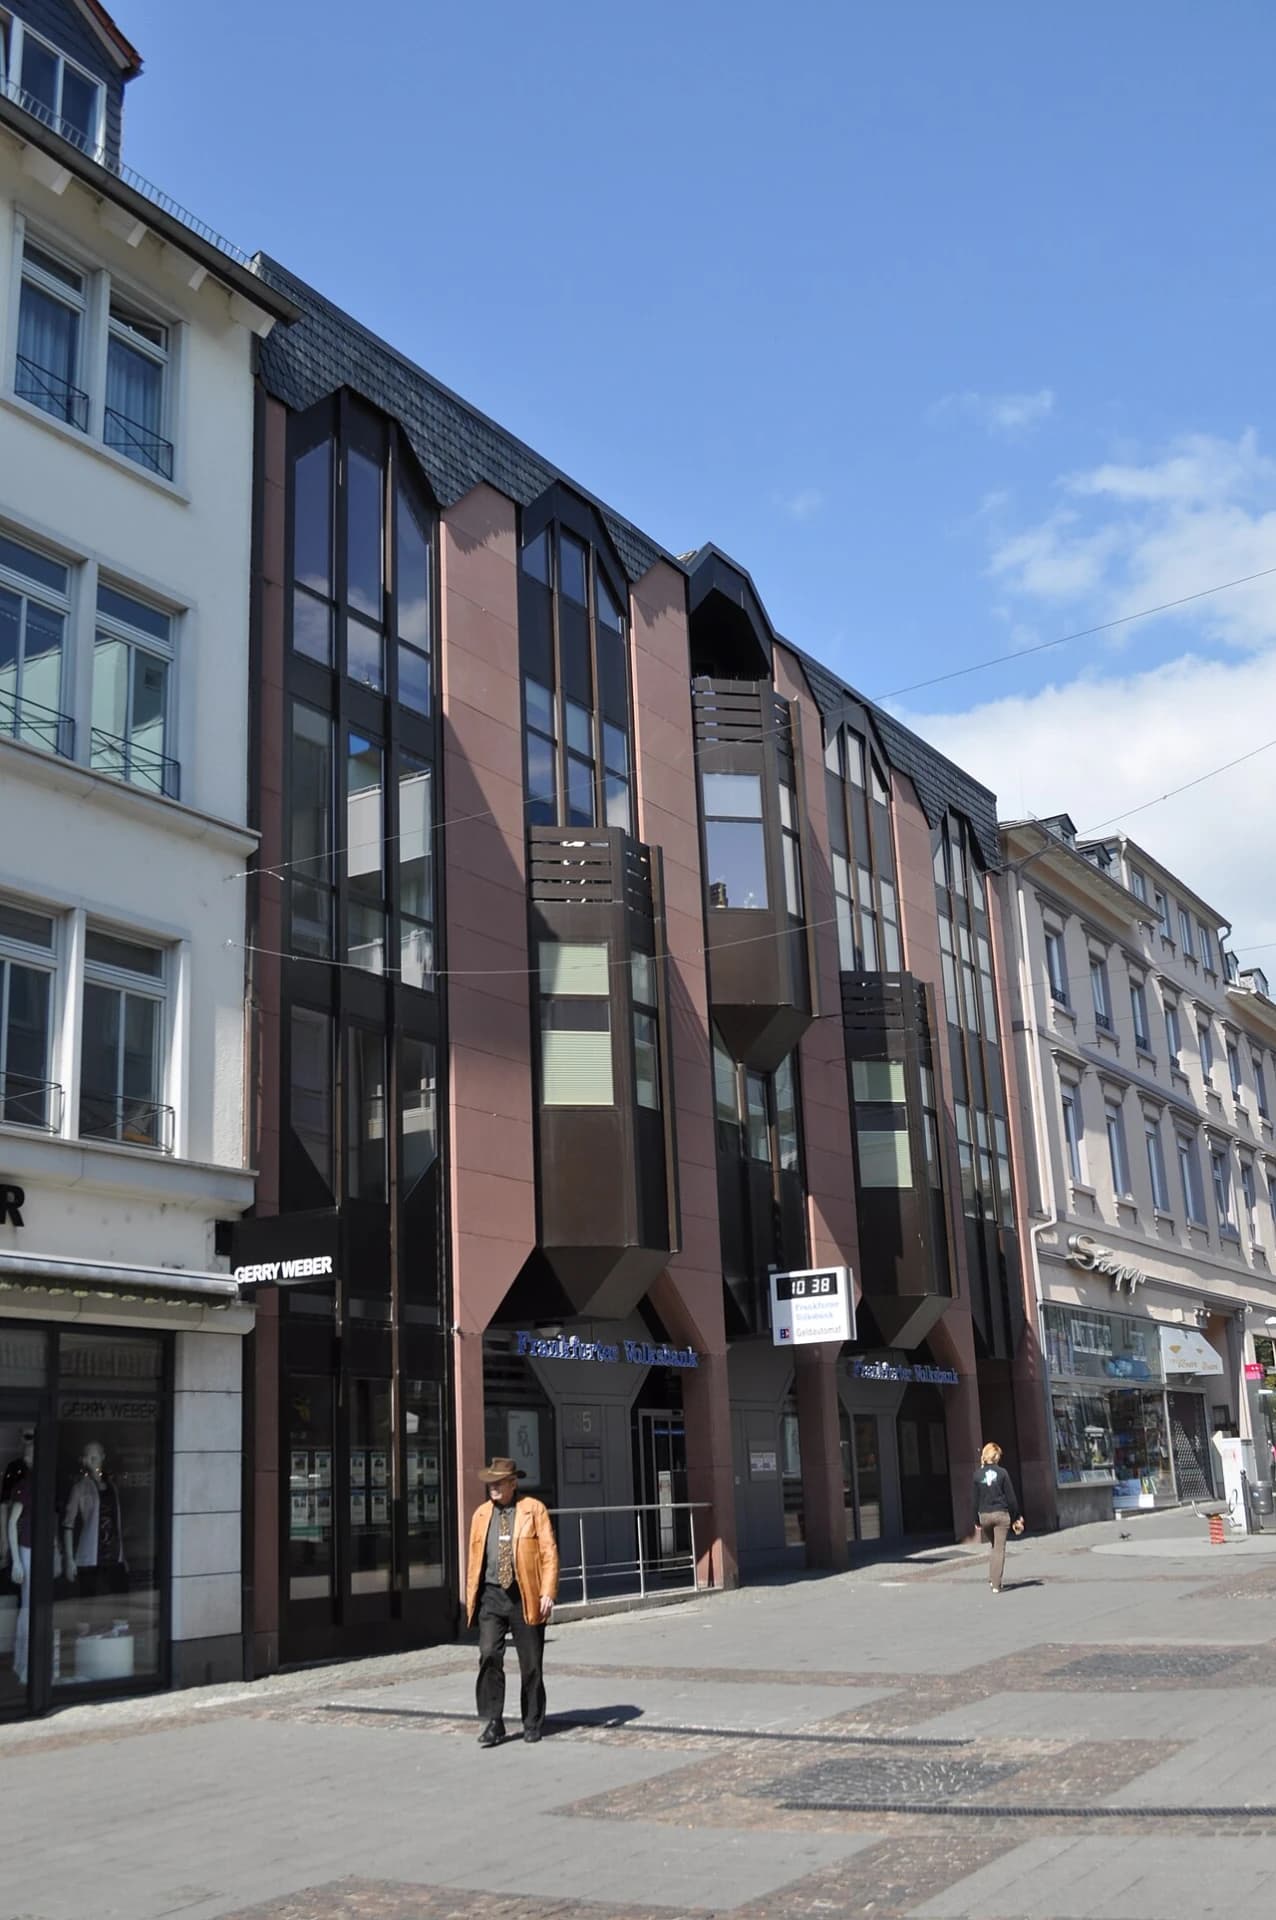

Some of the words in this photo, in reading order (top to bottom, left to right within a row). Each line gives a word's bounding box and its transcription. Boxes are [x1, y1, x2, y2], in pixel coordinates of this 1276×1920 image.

[0, 1184, 25, 1227] R
[233, 1262, 280, 1284] GERRY
[281, 1256, 332, 1278] WEBER
[792, 1280, 805, 1295] 10
[811, 1277, 830, 1293] 38
[516, 1331, 618, 1363] Frankfurter
[624, 1340, 698, 1367] Volksbank
[913, 1364, 959, 1384] Volksbank
